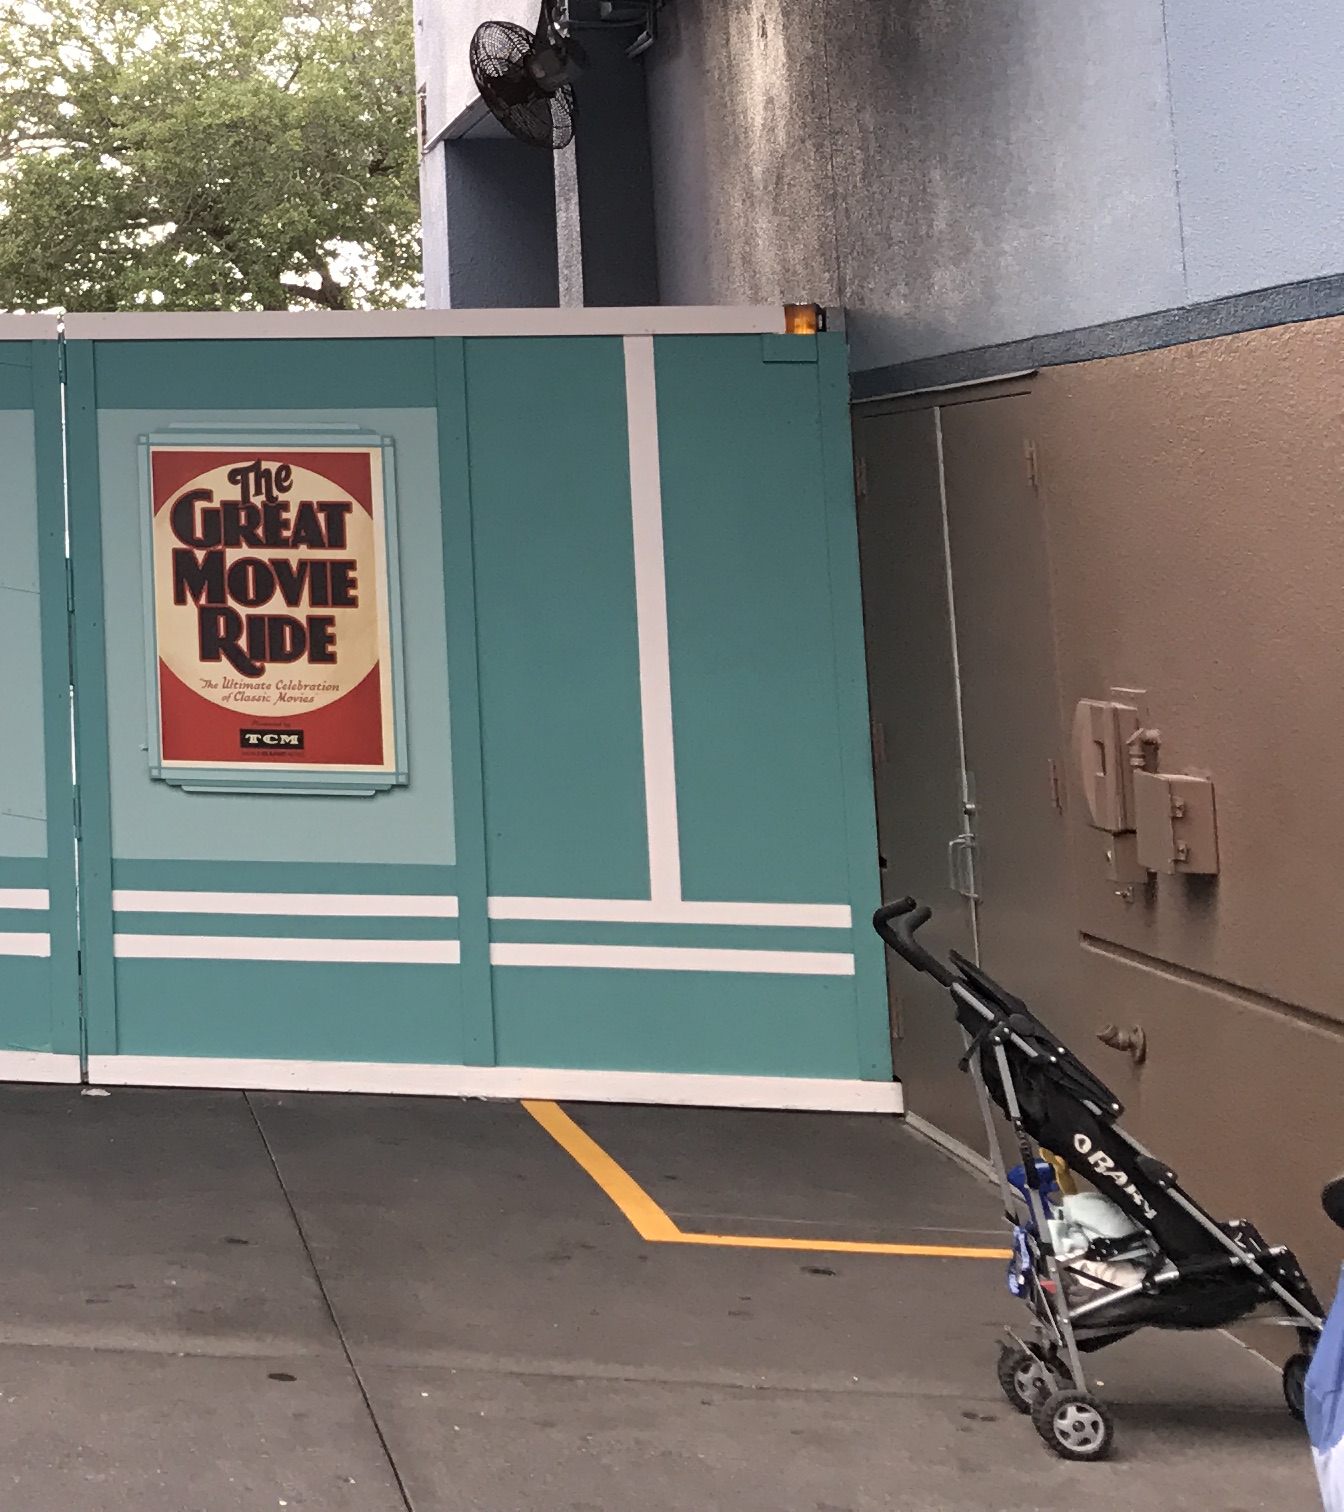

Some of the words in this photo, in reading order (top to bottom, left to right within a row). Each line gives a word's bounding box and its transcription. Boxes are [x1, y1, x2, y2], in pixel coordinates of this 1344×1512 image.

[227, 458, 293, 504] The
[170, 488, 353, 550] GREAT
[172, 547, 359, 609] MOVIE
[198, 603, 337, 679] RIDE
[221, 692, 233, 702] of
[233, 691, 271, 702] Classic
[222, 676, 272, 690] Ultimate
[275, 679, 340, 692] Celebration
[245, 734, 299, 745] TCM
